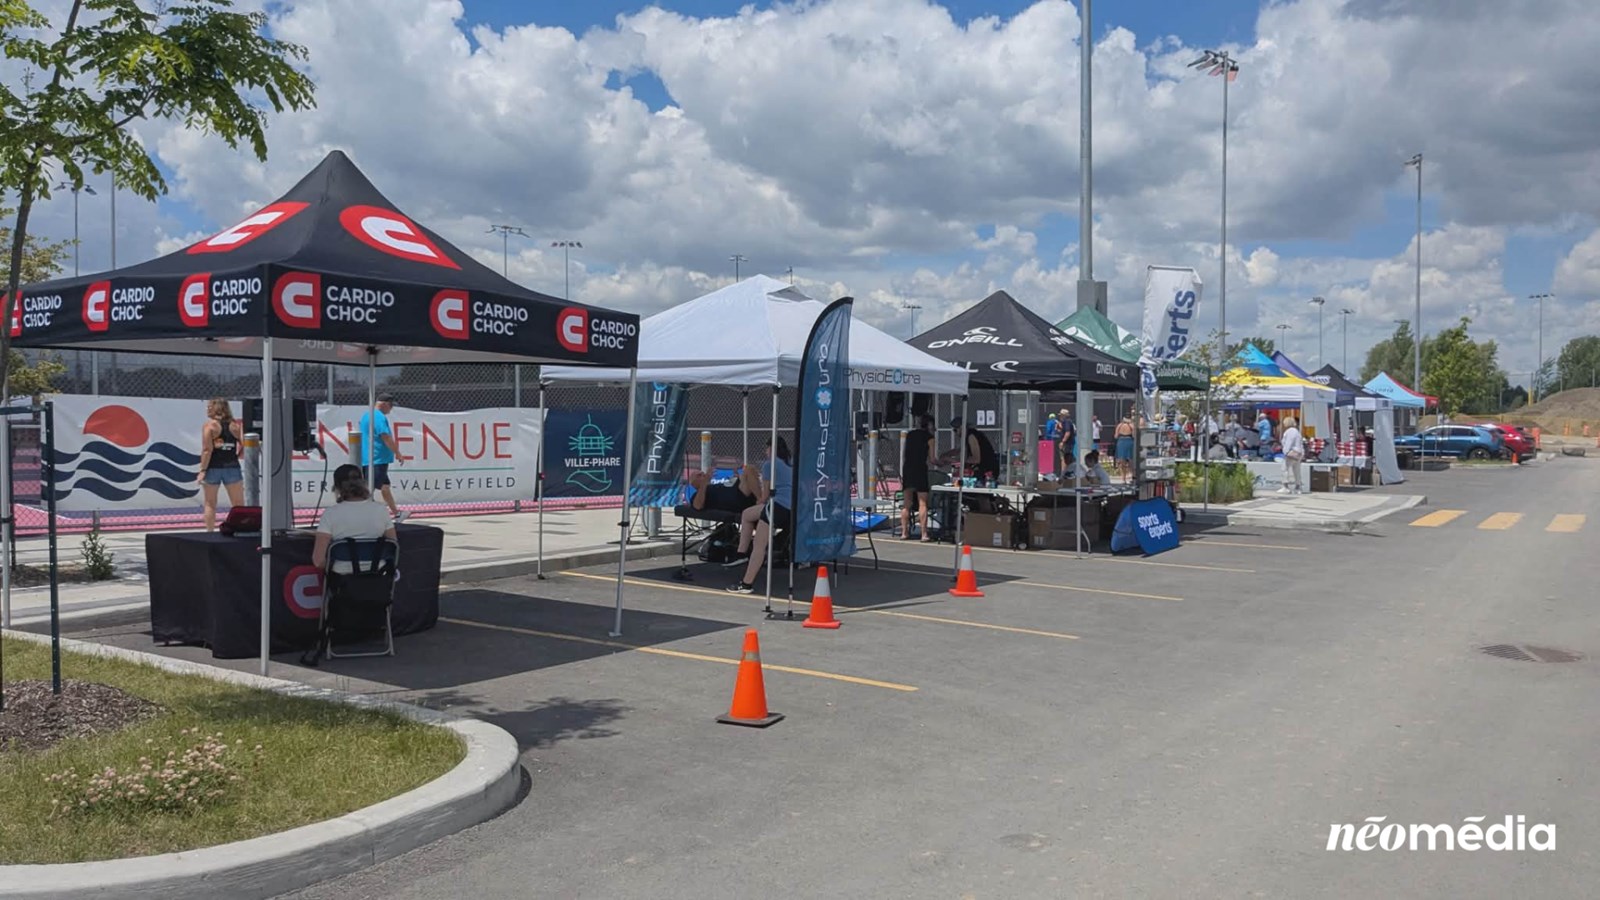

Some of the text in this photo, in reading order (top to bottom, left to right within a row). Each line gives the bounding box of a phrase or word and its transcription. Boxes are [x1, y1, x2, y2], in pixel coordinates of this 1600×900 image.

[112, 286, 155, 304] CARDIO
[213, 277, 262, 297] CARDIO
[326, 285, 395, 308] CARDIO
[24, 295, 62, 312] CARDIO
[111, 303, 144, 322] CHOC
[212, 297, 249, 316] CHOC
[473, 301, 529, 323] CARDIO
[326, 304, 377, 324] CHOC
[473, 318, 515, 336] CHOC
[591, 318, 636, 337] CARDIO
[1167, 290, 1195, 359] erts
[591, 332, 625, 350] CHOC
[1137, 512, 1160, 531] sports
[1148, 520, 1173, 540] experts
